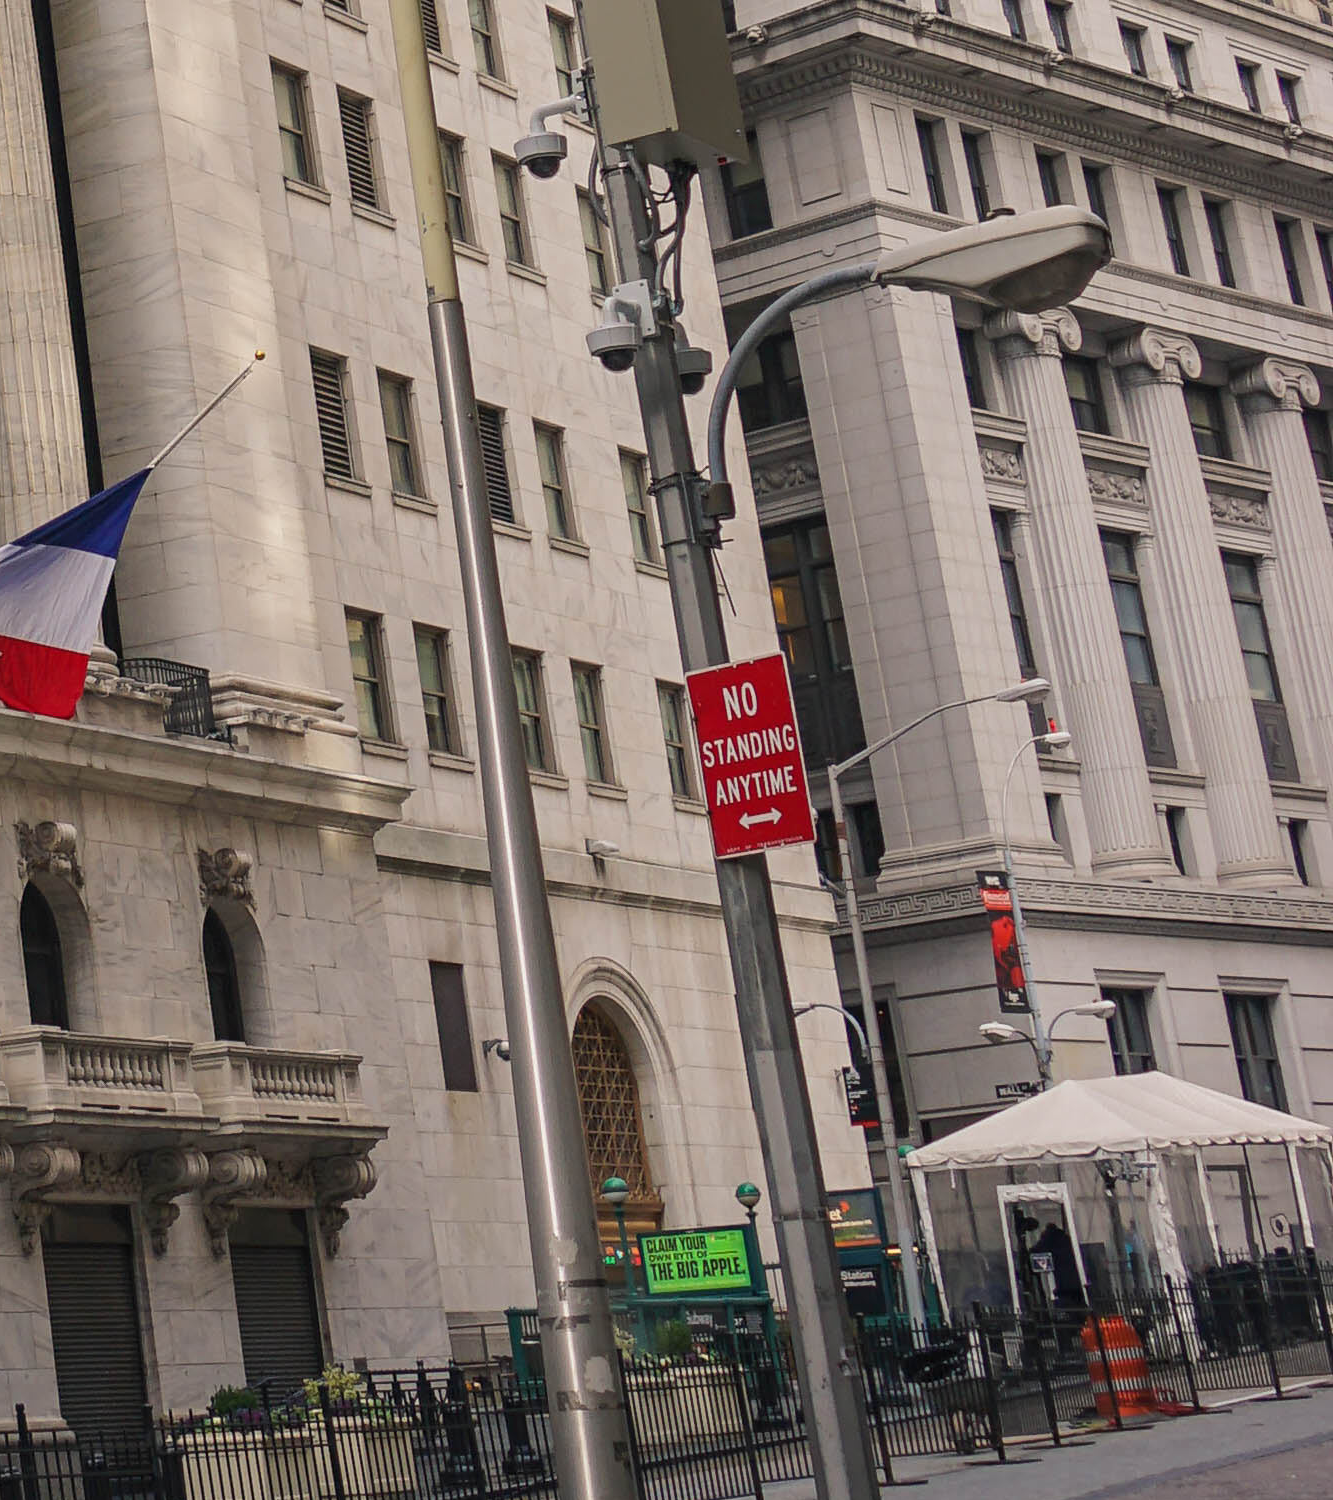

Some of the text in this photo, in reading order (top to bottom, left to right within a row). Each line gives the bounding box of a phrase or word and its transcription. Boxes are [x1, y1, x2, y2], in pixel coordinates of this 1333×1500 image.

[722, 681, 758, 721] NO
[701, 723, 796, 769] STANDING
[715, 764, 798, 807] ANYTIME
[645, 1238, 678, 1254] CLAIM
[679, 1235, 708, 1250] YOUR
[648, 1253, 672, 1263] OWN
[649, 1256, 747, 1281] THE BIG APPLE.
